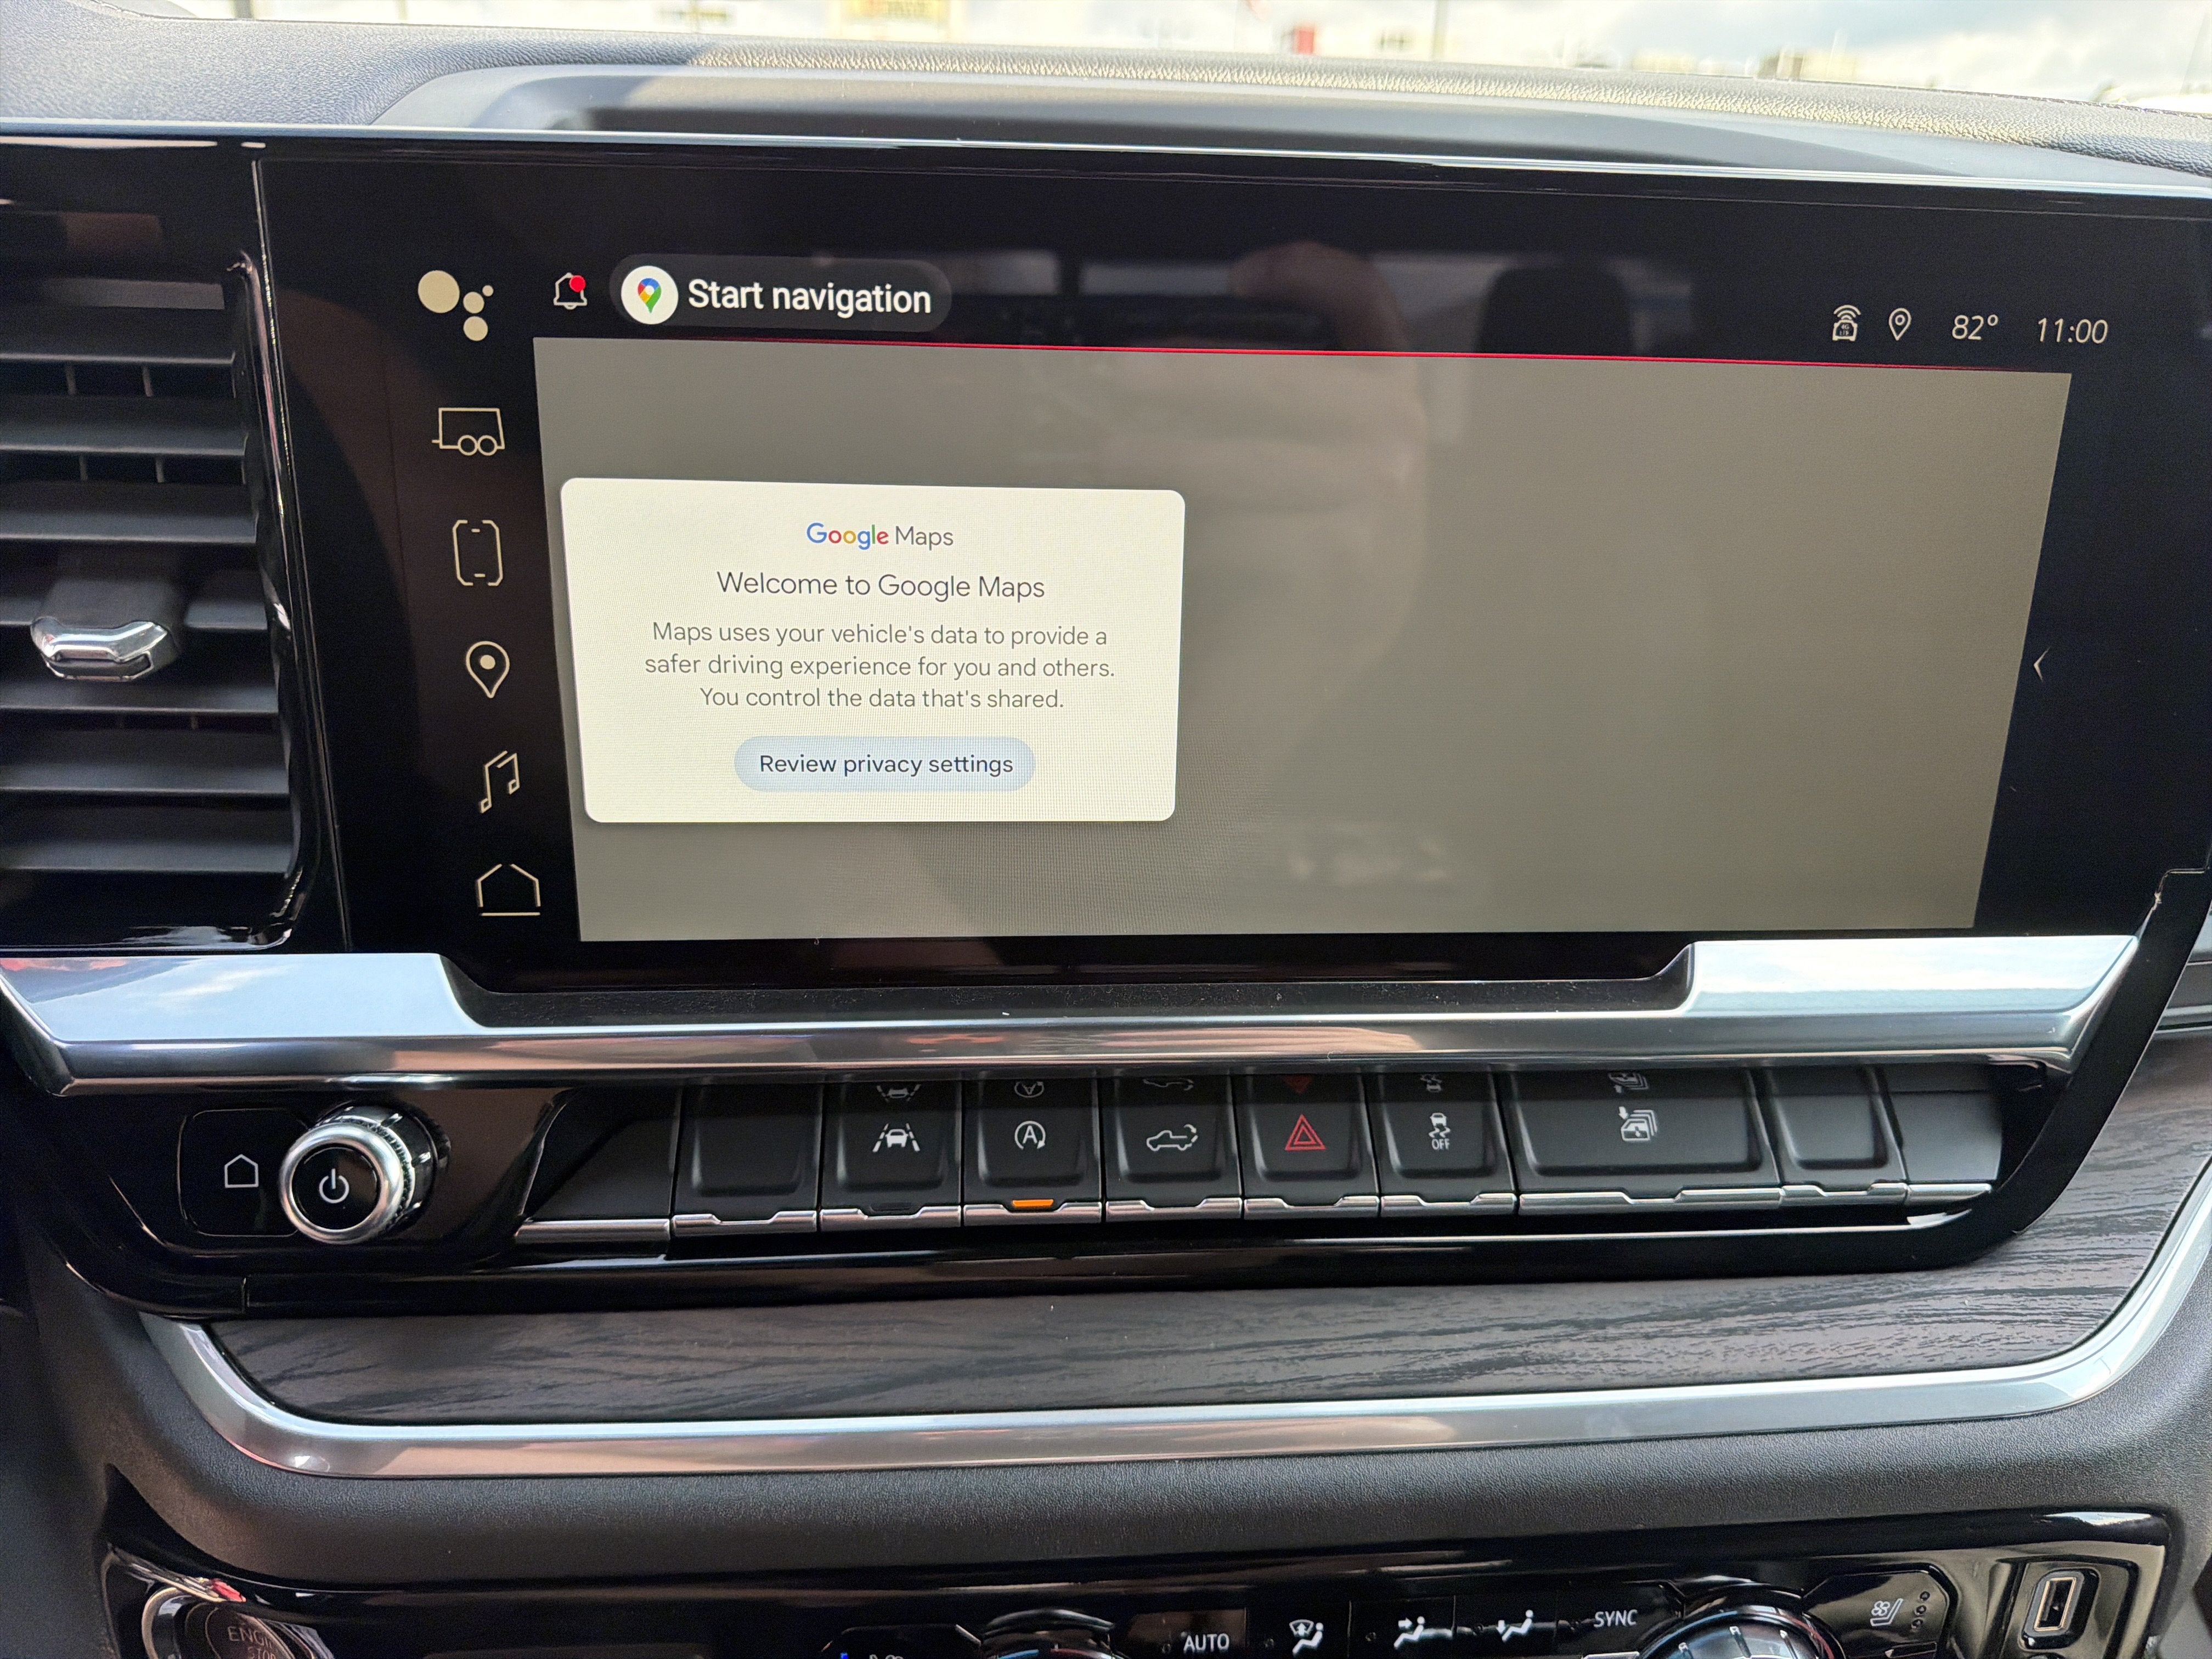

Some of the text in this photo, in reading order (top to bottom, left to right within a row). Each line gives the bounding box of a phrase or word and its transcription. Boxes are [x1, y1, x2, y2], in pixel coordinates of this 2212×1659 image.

[689, 279, 931, 319] Start navigation
[1952, 314, 1999, 340] 82°
[2038, 318, 2108, 344] 11:00
[806, 522, 954, 551] Google Maps
[716, 571, 1045, 603] Welcome to Google Maps
[653, 621, 1107, 650] Maps uses your vehicle's data to provide a
[645, 653, 1114, 681] safer driving experience for you and others.
[699, 687, 1064, 708] You control the data that's shared.
[760, 754, 1013, 777] Review privacy settings
[1431, 1138, 1450, 1150] OFF
[1593, 1609, 1638, 1627] SYNC
[228, 1626, 276, 1649] ENGI
[1183, 1633, 1229, 1654] AUTO
